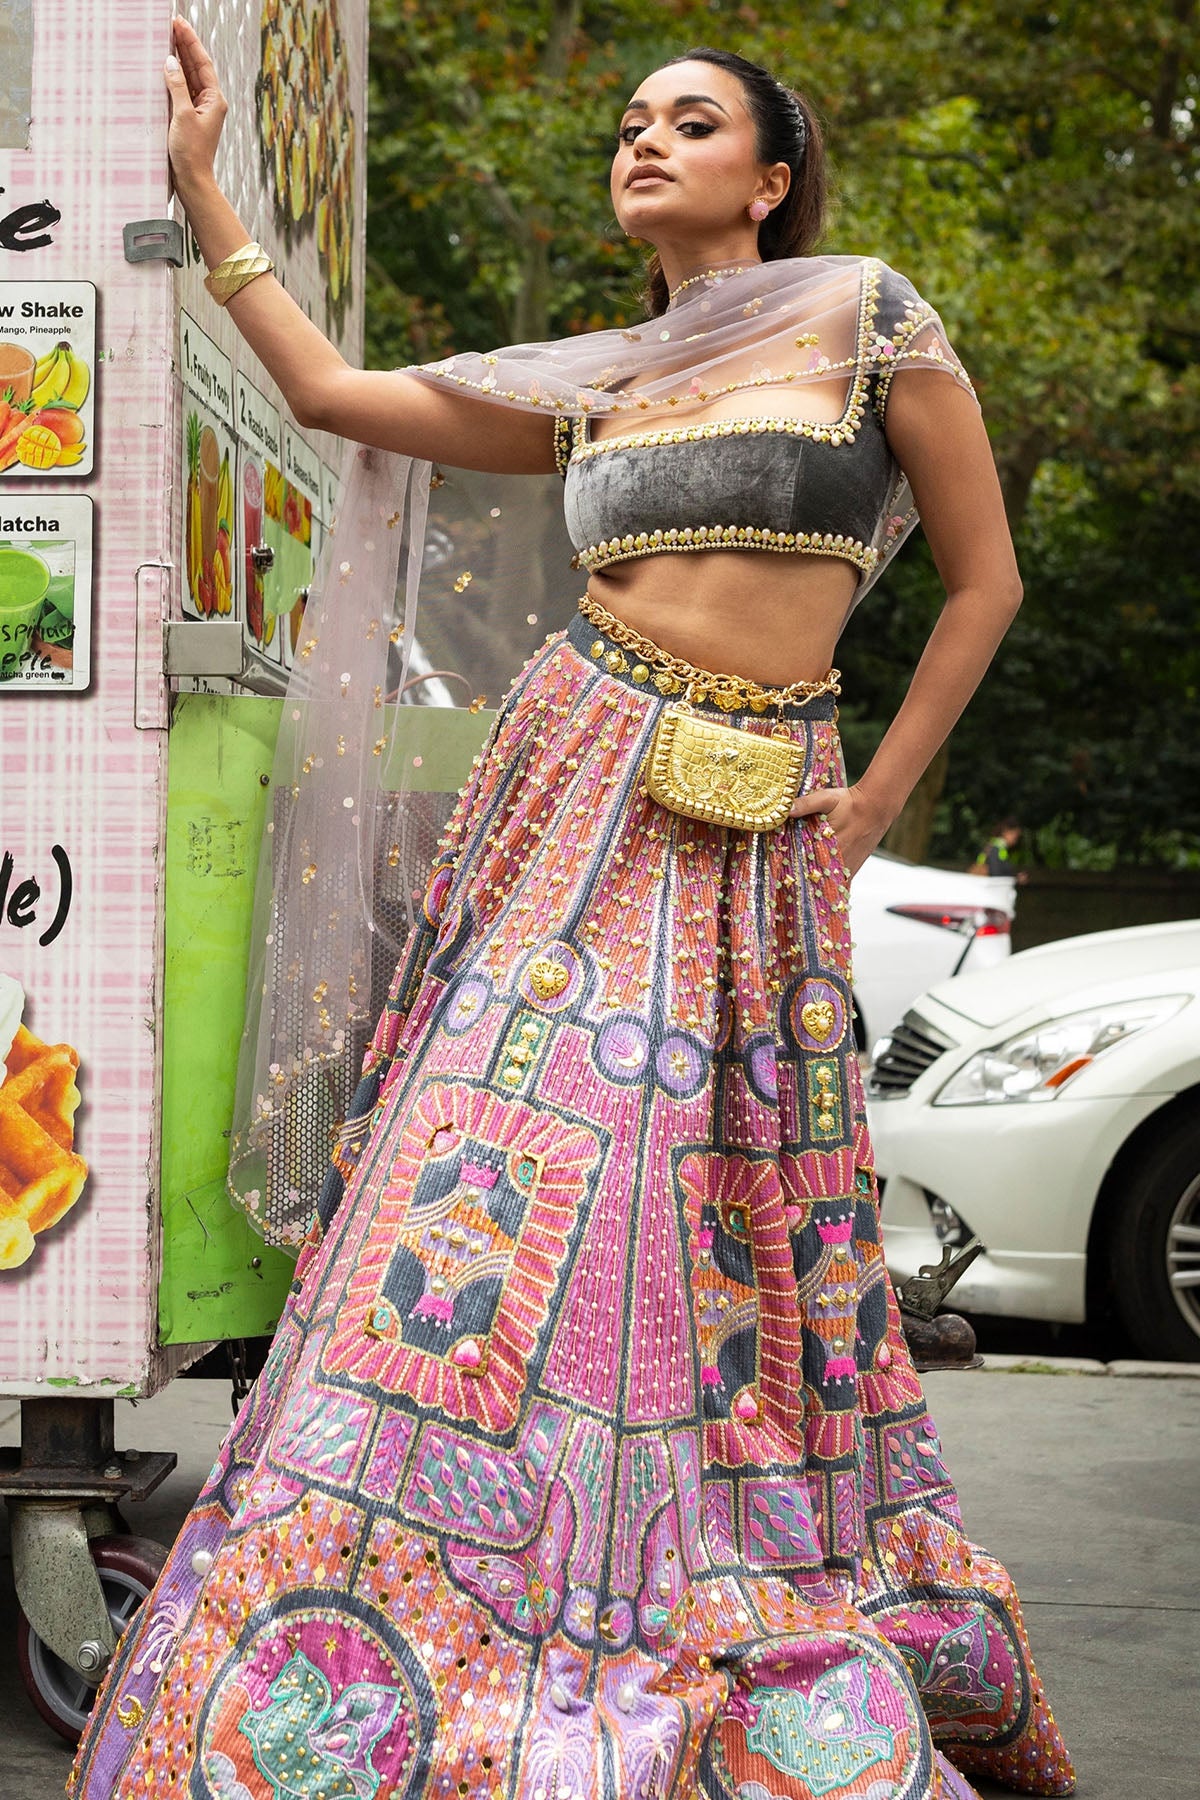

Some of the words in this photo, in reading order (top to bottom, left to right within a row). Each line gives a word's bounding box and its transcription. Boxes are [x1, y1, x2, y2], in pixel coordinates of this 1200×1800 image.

[0, 187, 61, 252] e
[21, 301, 83, 318] Shake
[29, 325, 72, 336] Pineapple
[0, 516, 60, 532] atcha
[25, 671, 50, 680] green
